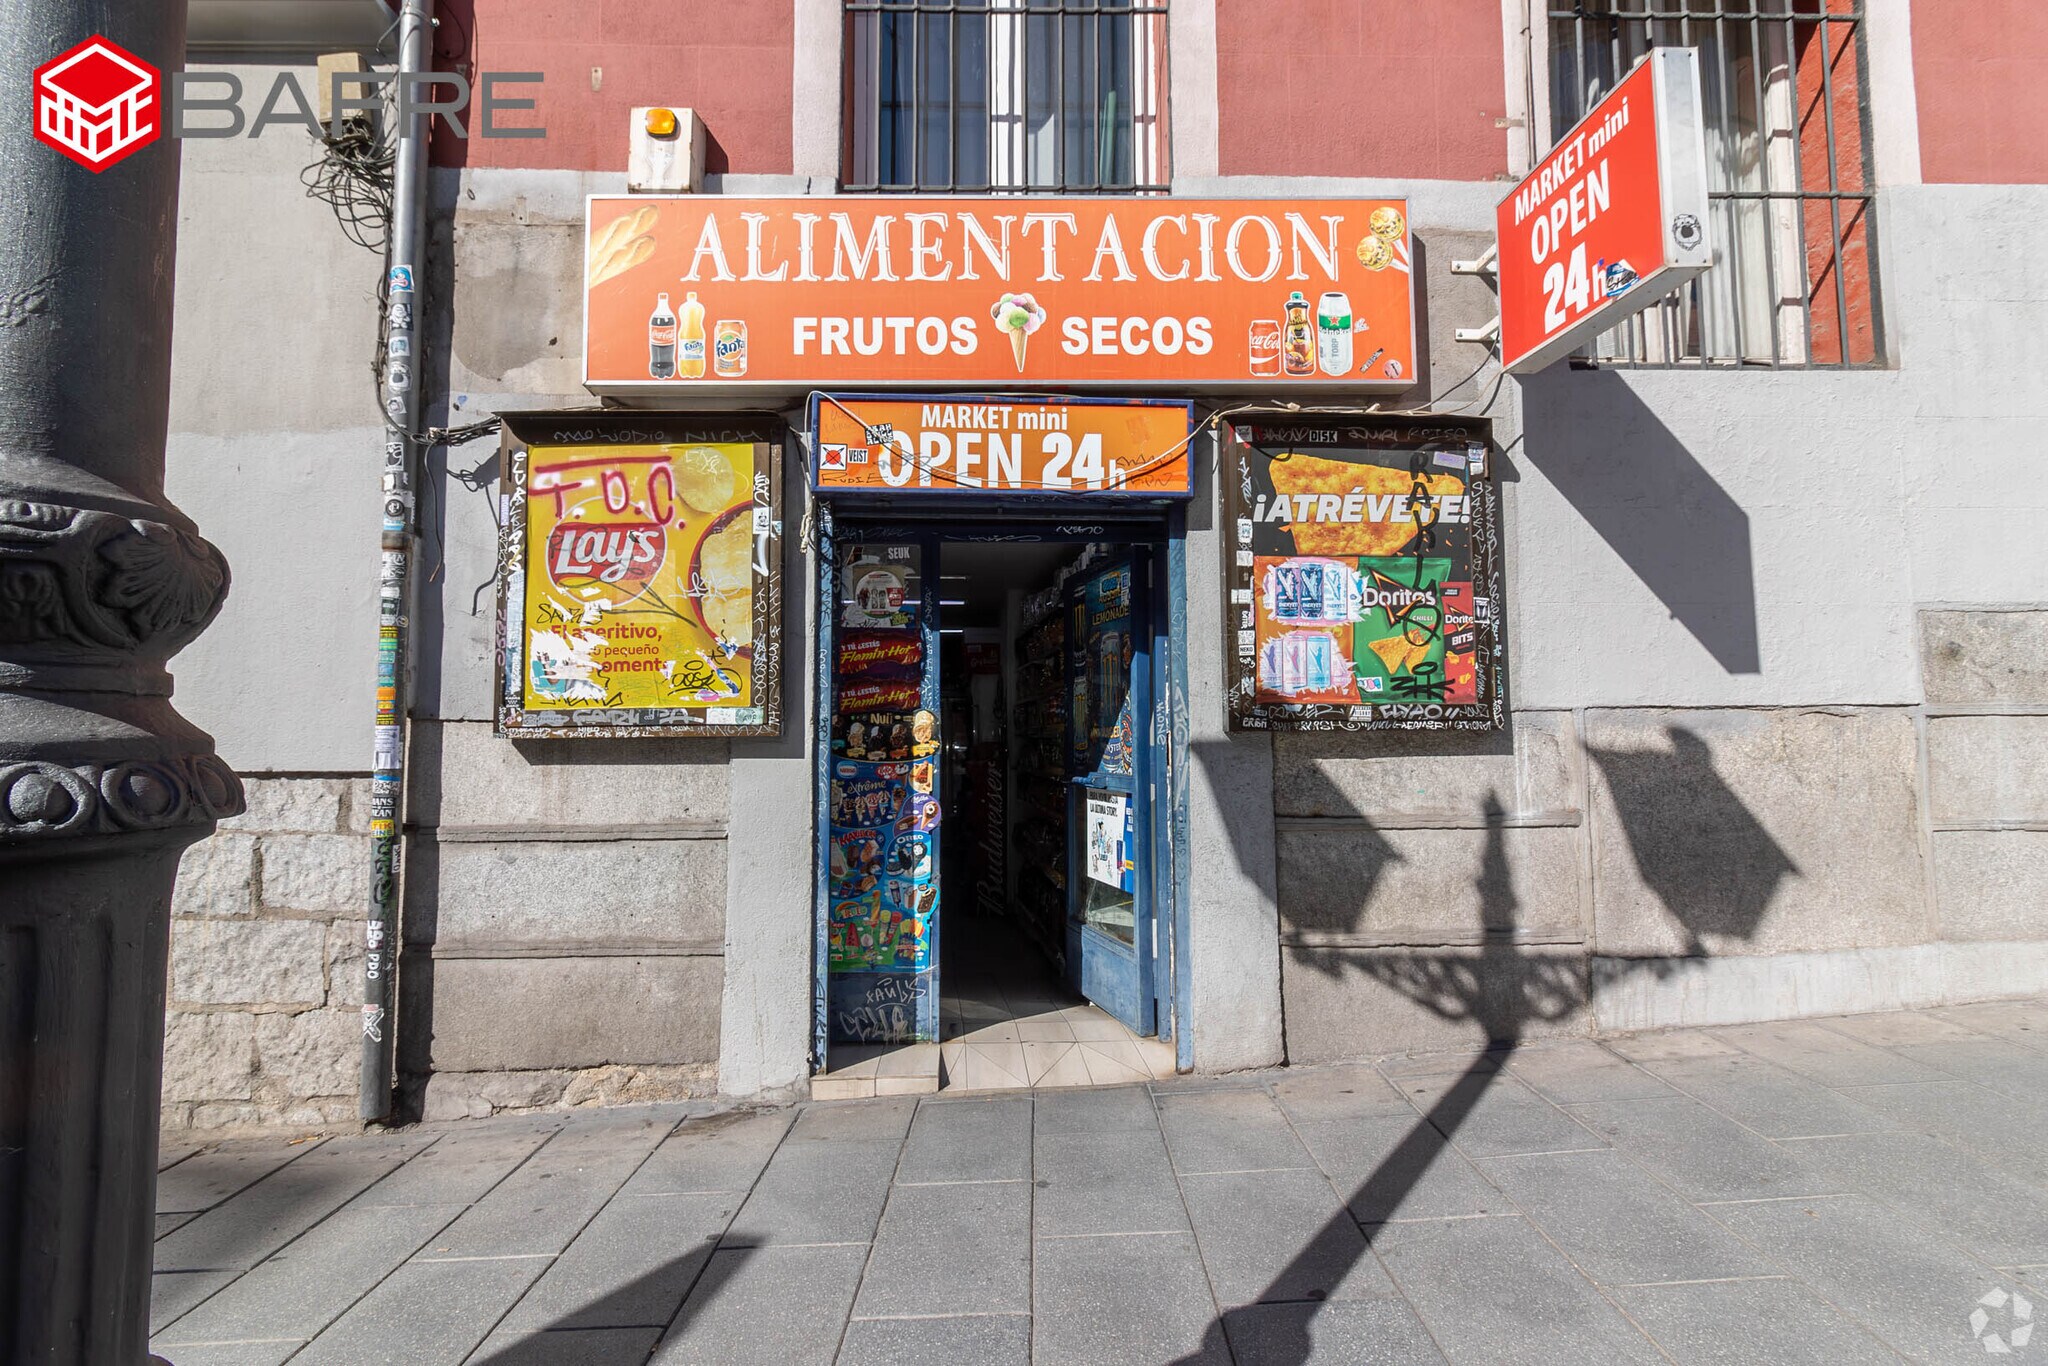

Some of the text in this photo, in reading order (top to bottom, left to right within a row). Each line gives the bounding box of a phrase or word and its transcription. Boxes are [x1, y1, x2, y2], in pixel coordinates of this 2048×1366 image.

[1514, 95, 1630, 226] MARKET mini
[1531, 158, 1611, 265] OPEN
[680, 211, 1346, 283] ALIMENTACION
[792, 315, 1213, 356] FRUTOS SECOS
[921, 405, 1068, 430] MARKET mini
[1309, 430, 1338, 442] DISK
[848, 449, 868, 462] VEIST
[878, 431, 1014, 490] OPEN
[1253, 486, 1471, 524] ¡ATRÉVETE!
[1361, 586, 1437, 608] Doritos
[1451, 632, 1474, 646] BITS
[604, 644, 660, 658] pequeño
[888, 645, 915, 657] Hot
[887, 690, 915, 702] Hot
